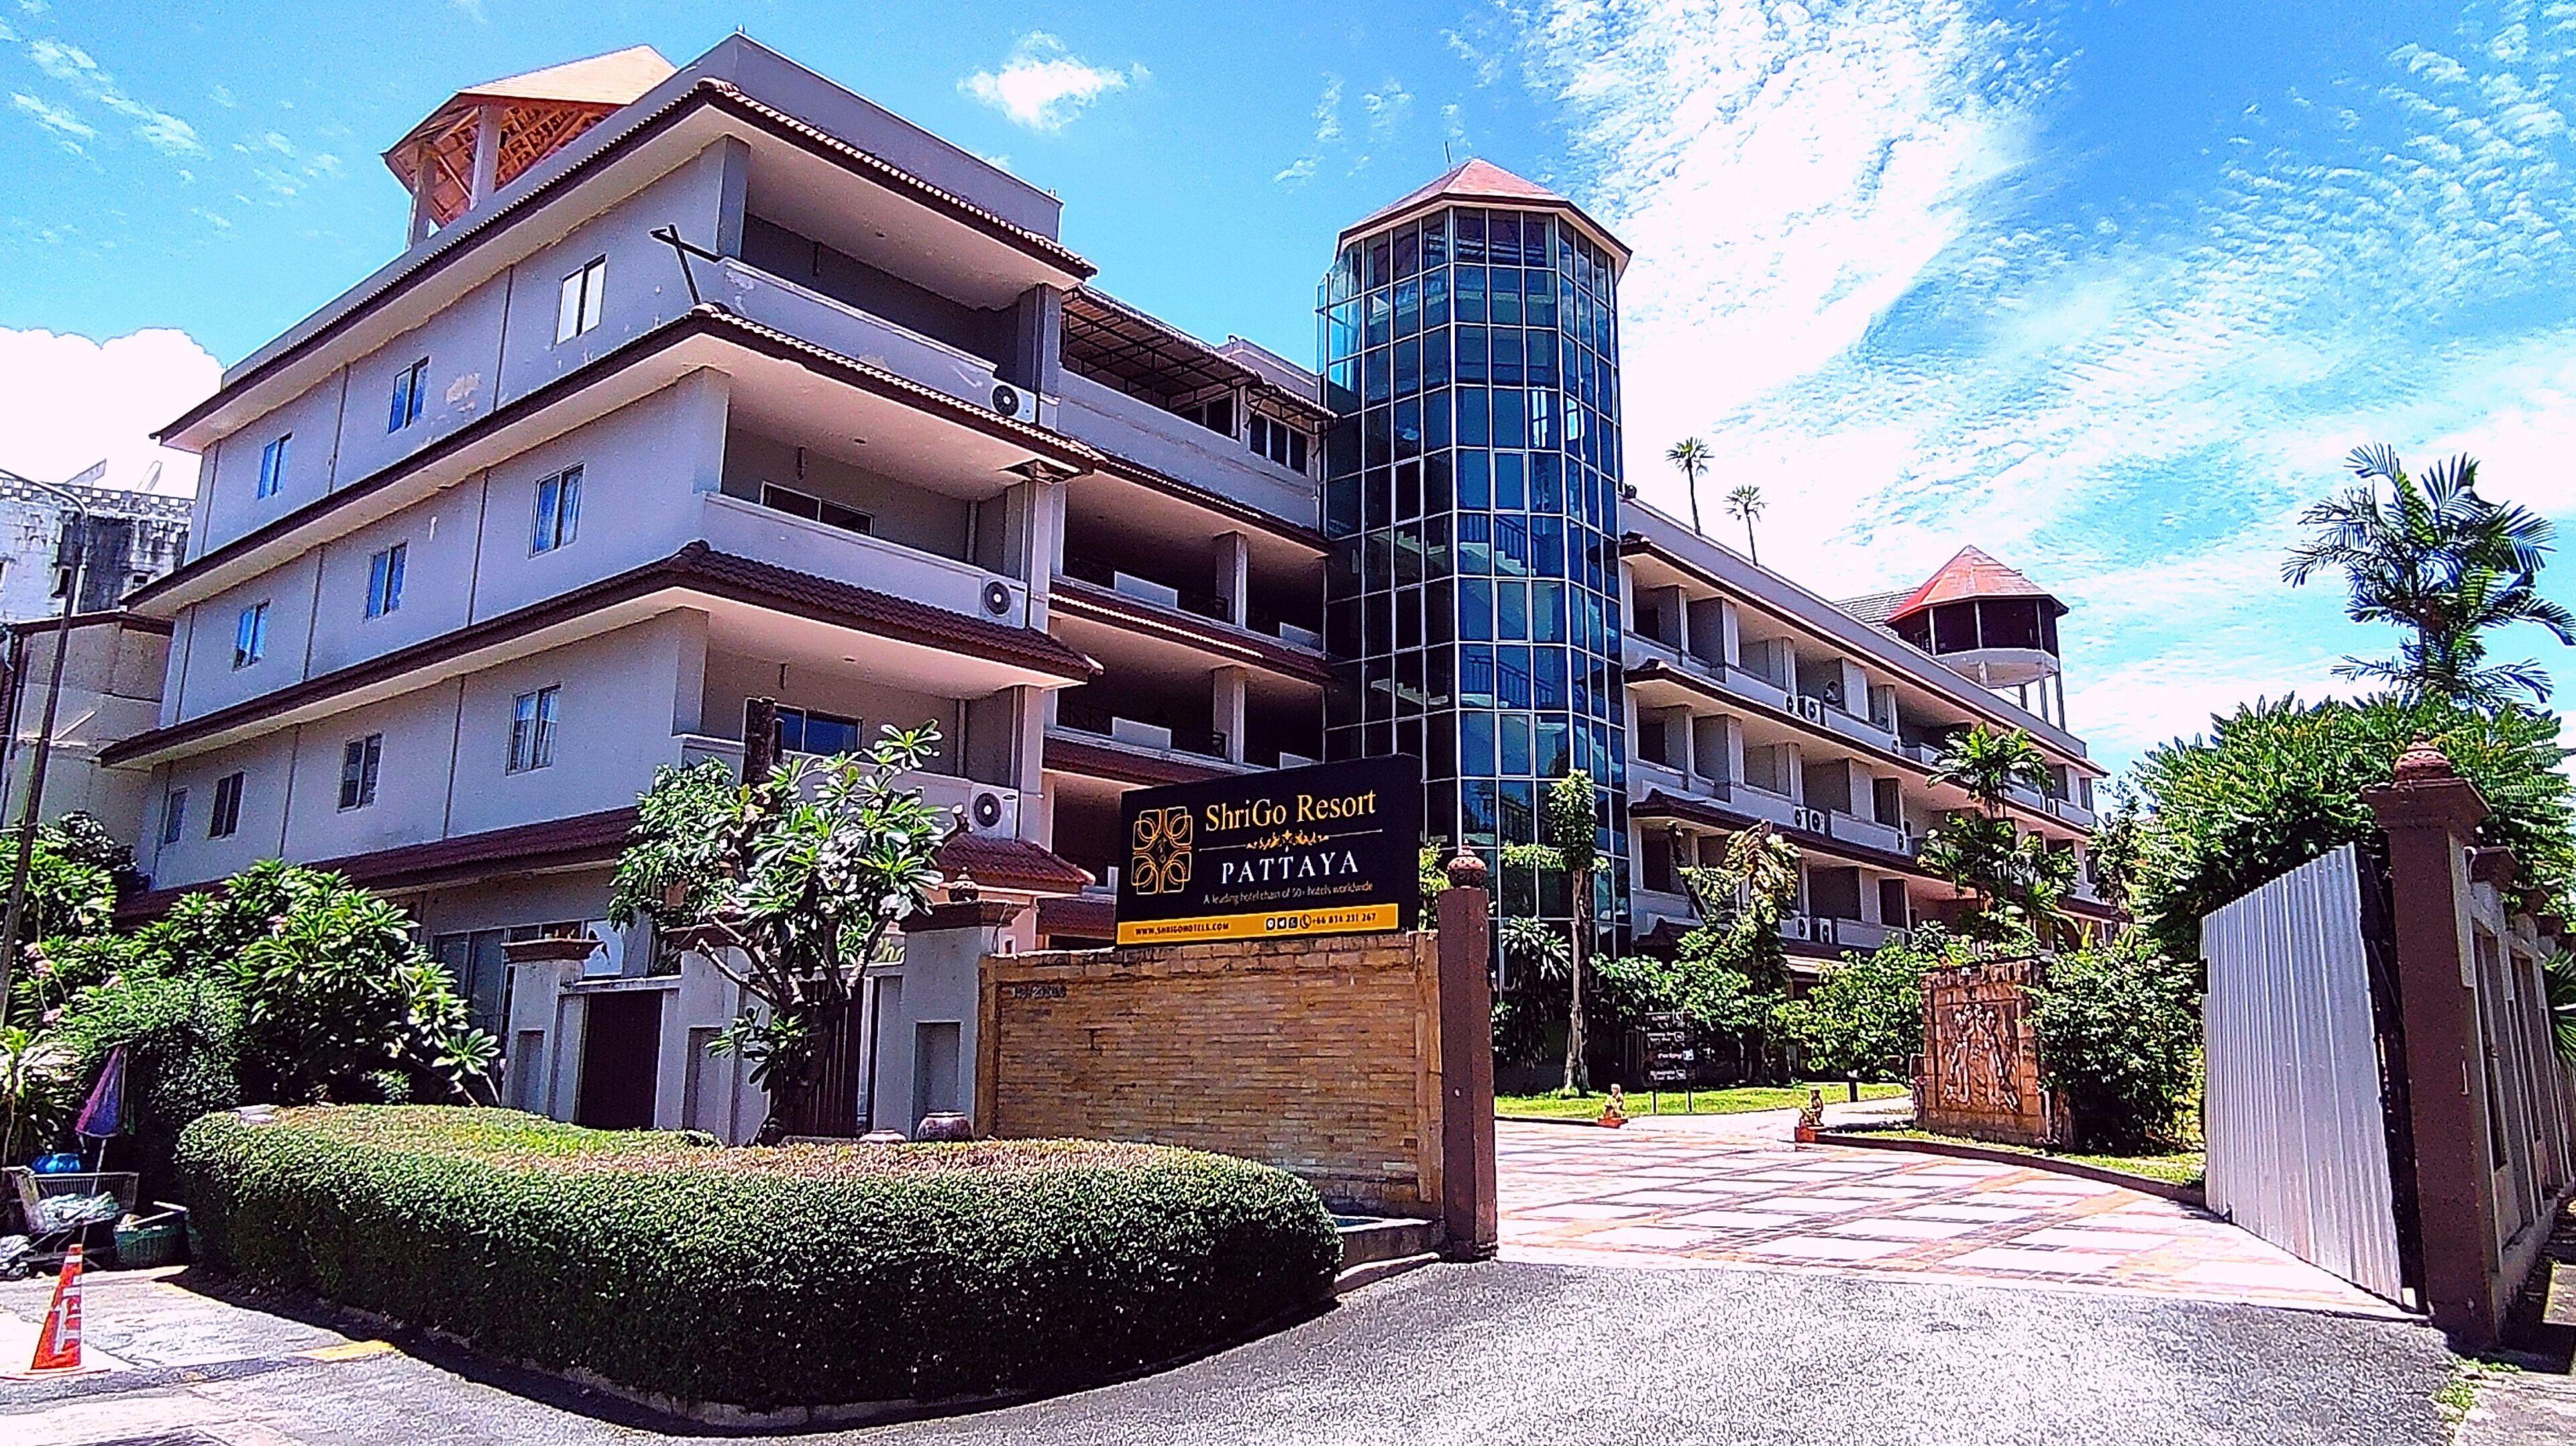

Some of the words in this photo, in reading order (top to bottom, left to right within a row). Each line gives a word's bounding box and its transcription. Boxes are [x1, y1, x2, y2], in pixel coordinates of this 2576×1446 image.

[1205, 798, 1287, 832] ShriGo
[1296, 789, 1377, 822] Resort
[1221, 850, 1358, 884] PATTAYA
